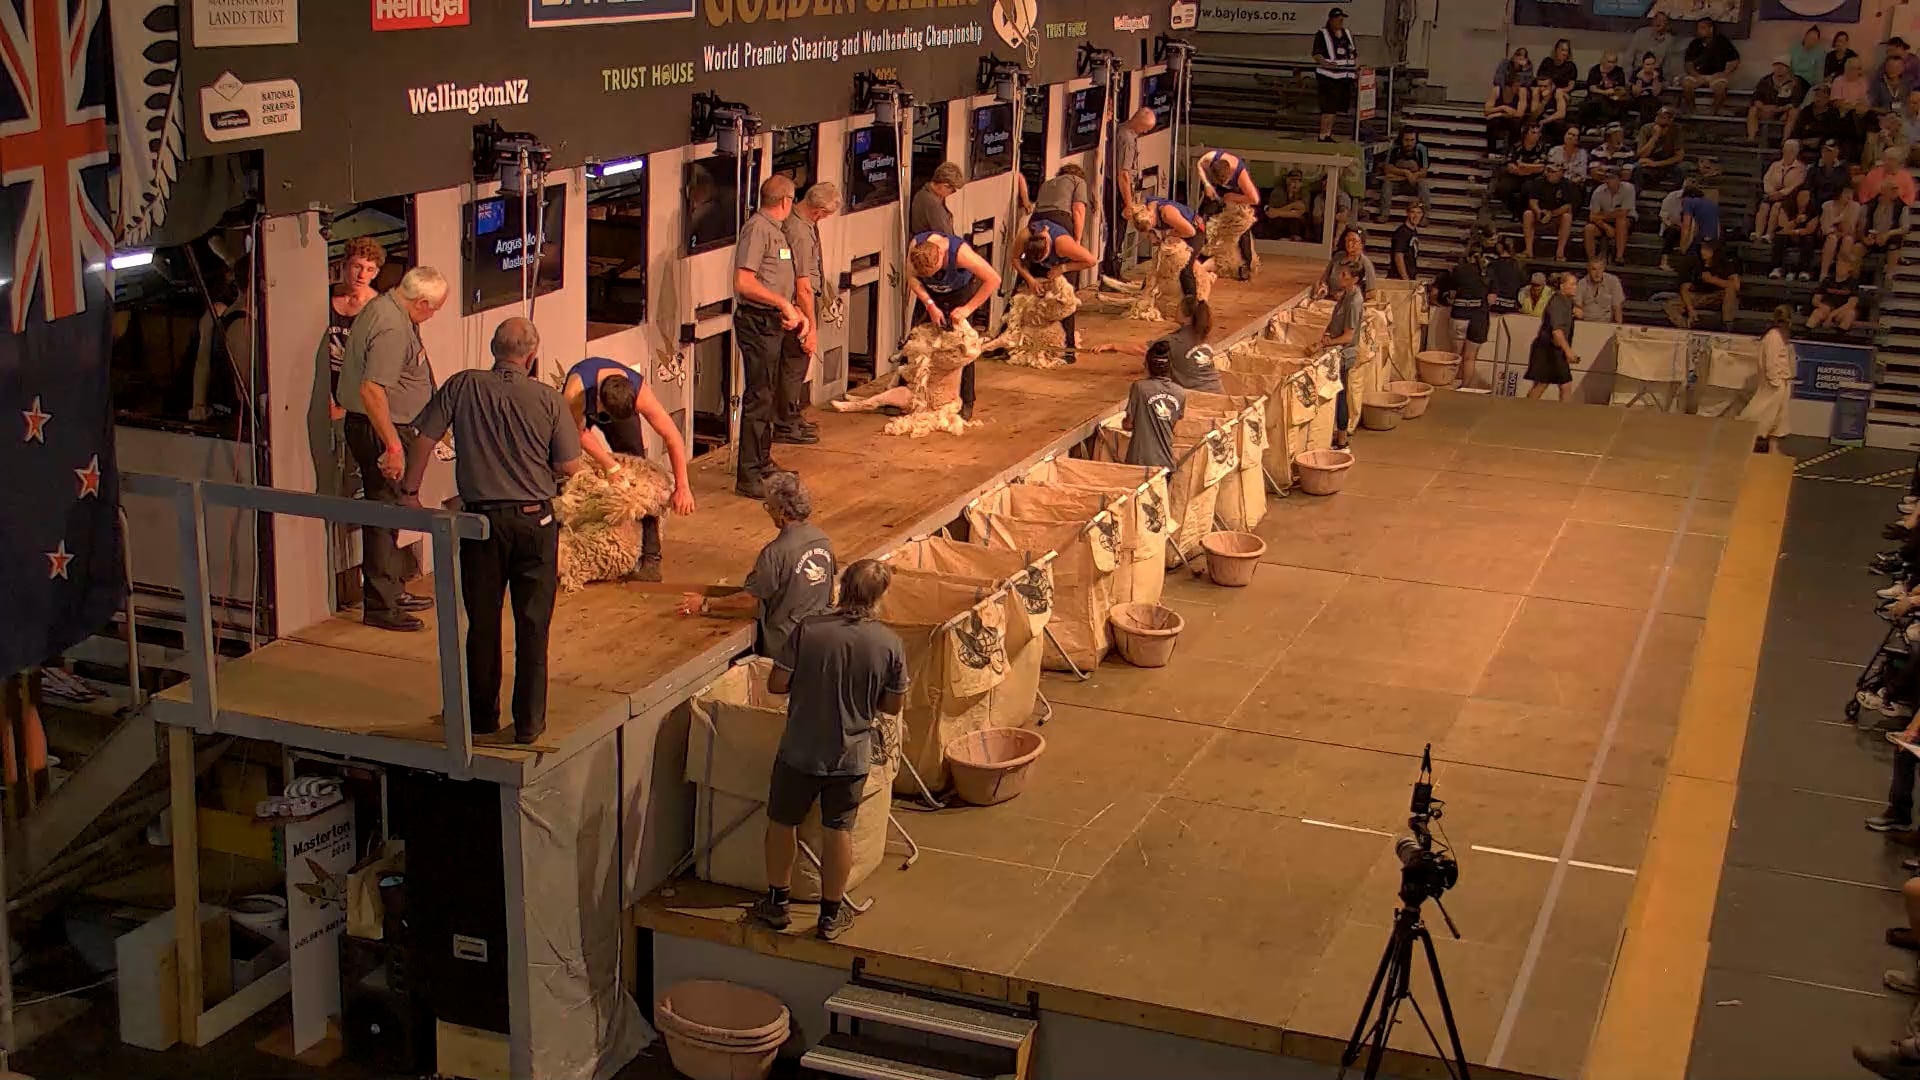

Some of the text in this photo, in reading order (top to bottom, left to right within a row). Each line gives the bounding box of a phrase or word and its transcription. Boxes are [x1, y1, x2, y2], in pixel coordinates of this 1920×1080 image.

[208, 9, 284, 25] LANDS TRUST
[703, 20, 982, 72] World Premier Shearing and Woolhandling Championship
[602, 62, 695, 91] TRUST HOUSE
[408, 79, 529, 115] WellingtonNZ
[495, 238, 523, 254] Angus
[293, 821, 351, 858] Masterton
